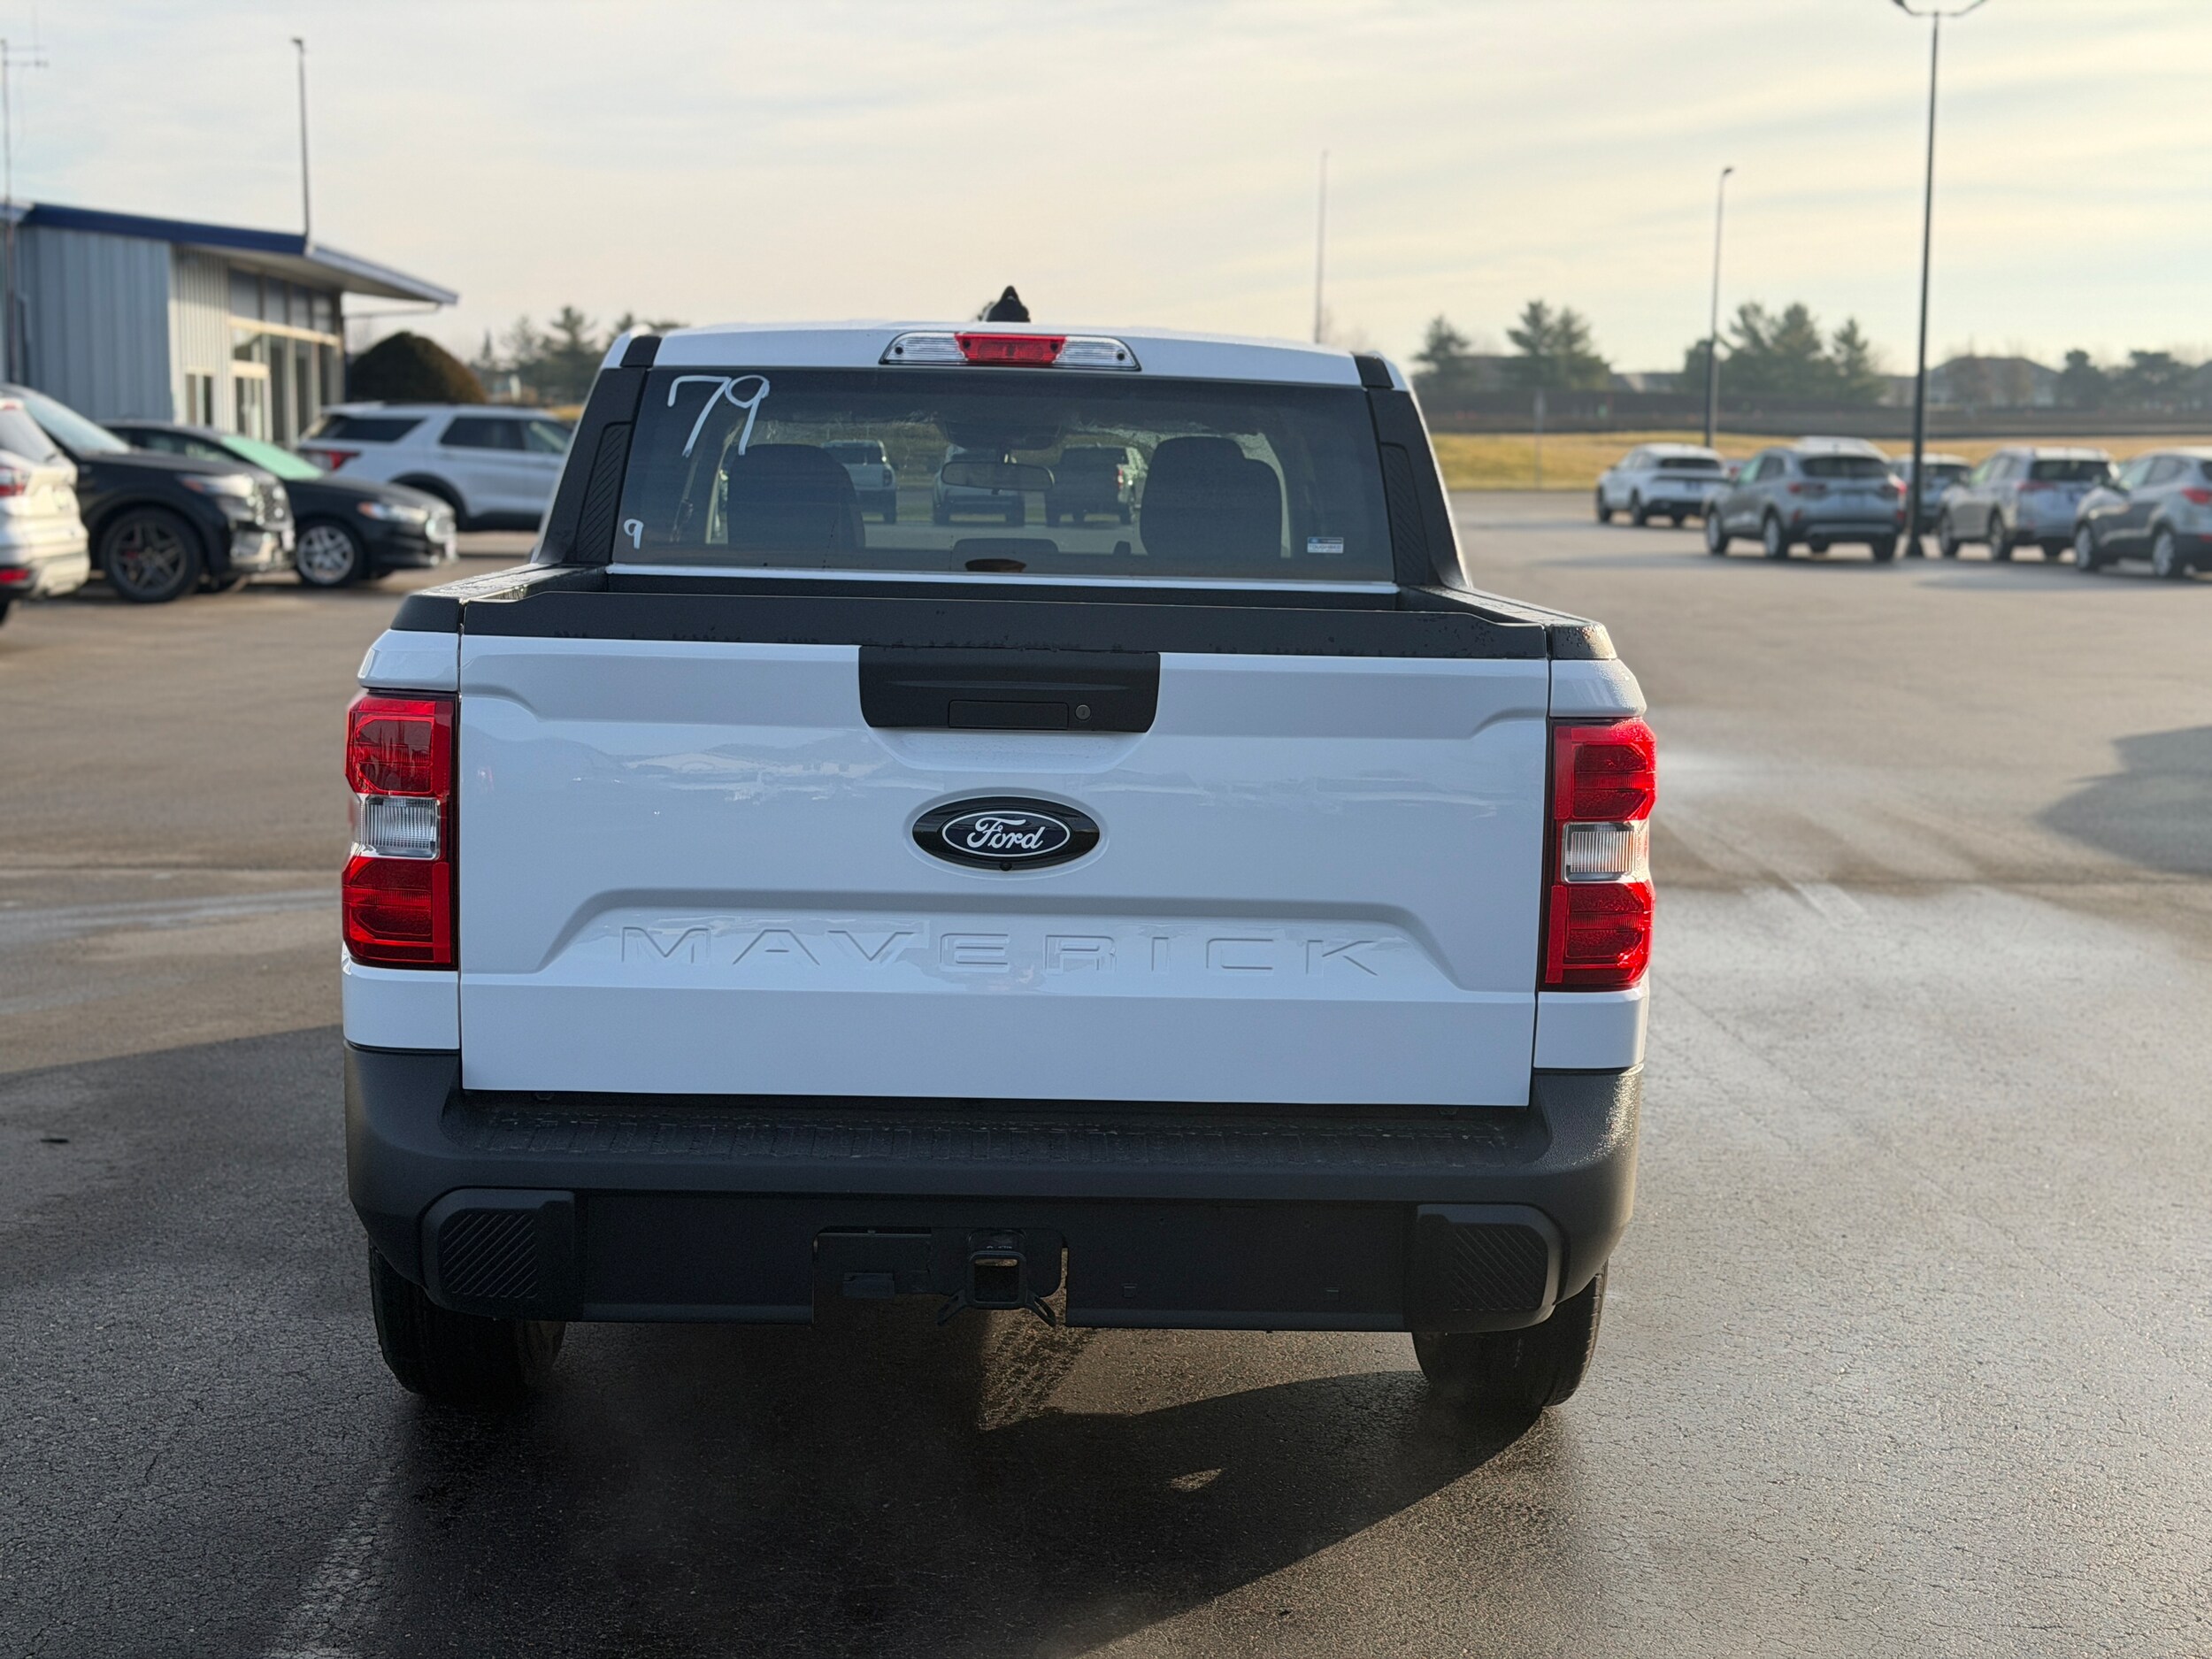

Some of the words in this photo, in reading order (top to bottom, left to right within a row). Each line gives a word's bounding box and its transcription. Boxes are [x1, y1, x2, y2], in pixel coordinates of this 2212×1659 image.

[667, 374, 770, 457] 79
[623, 518, 644, 549] 9
[966, 817, 1046, 849] Ford
[621, 926, 1379, 977] MAVERICK
